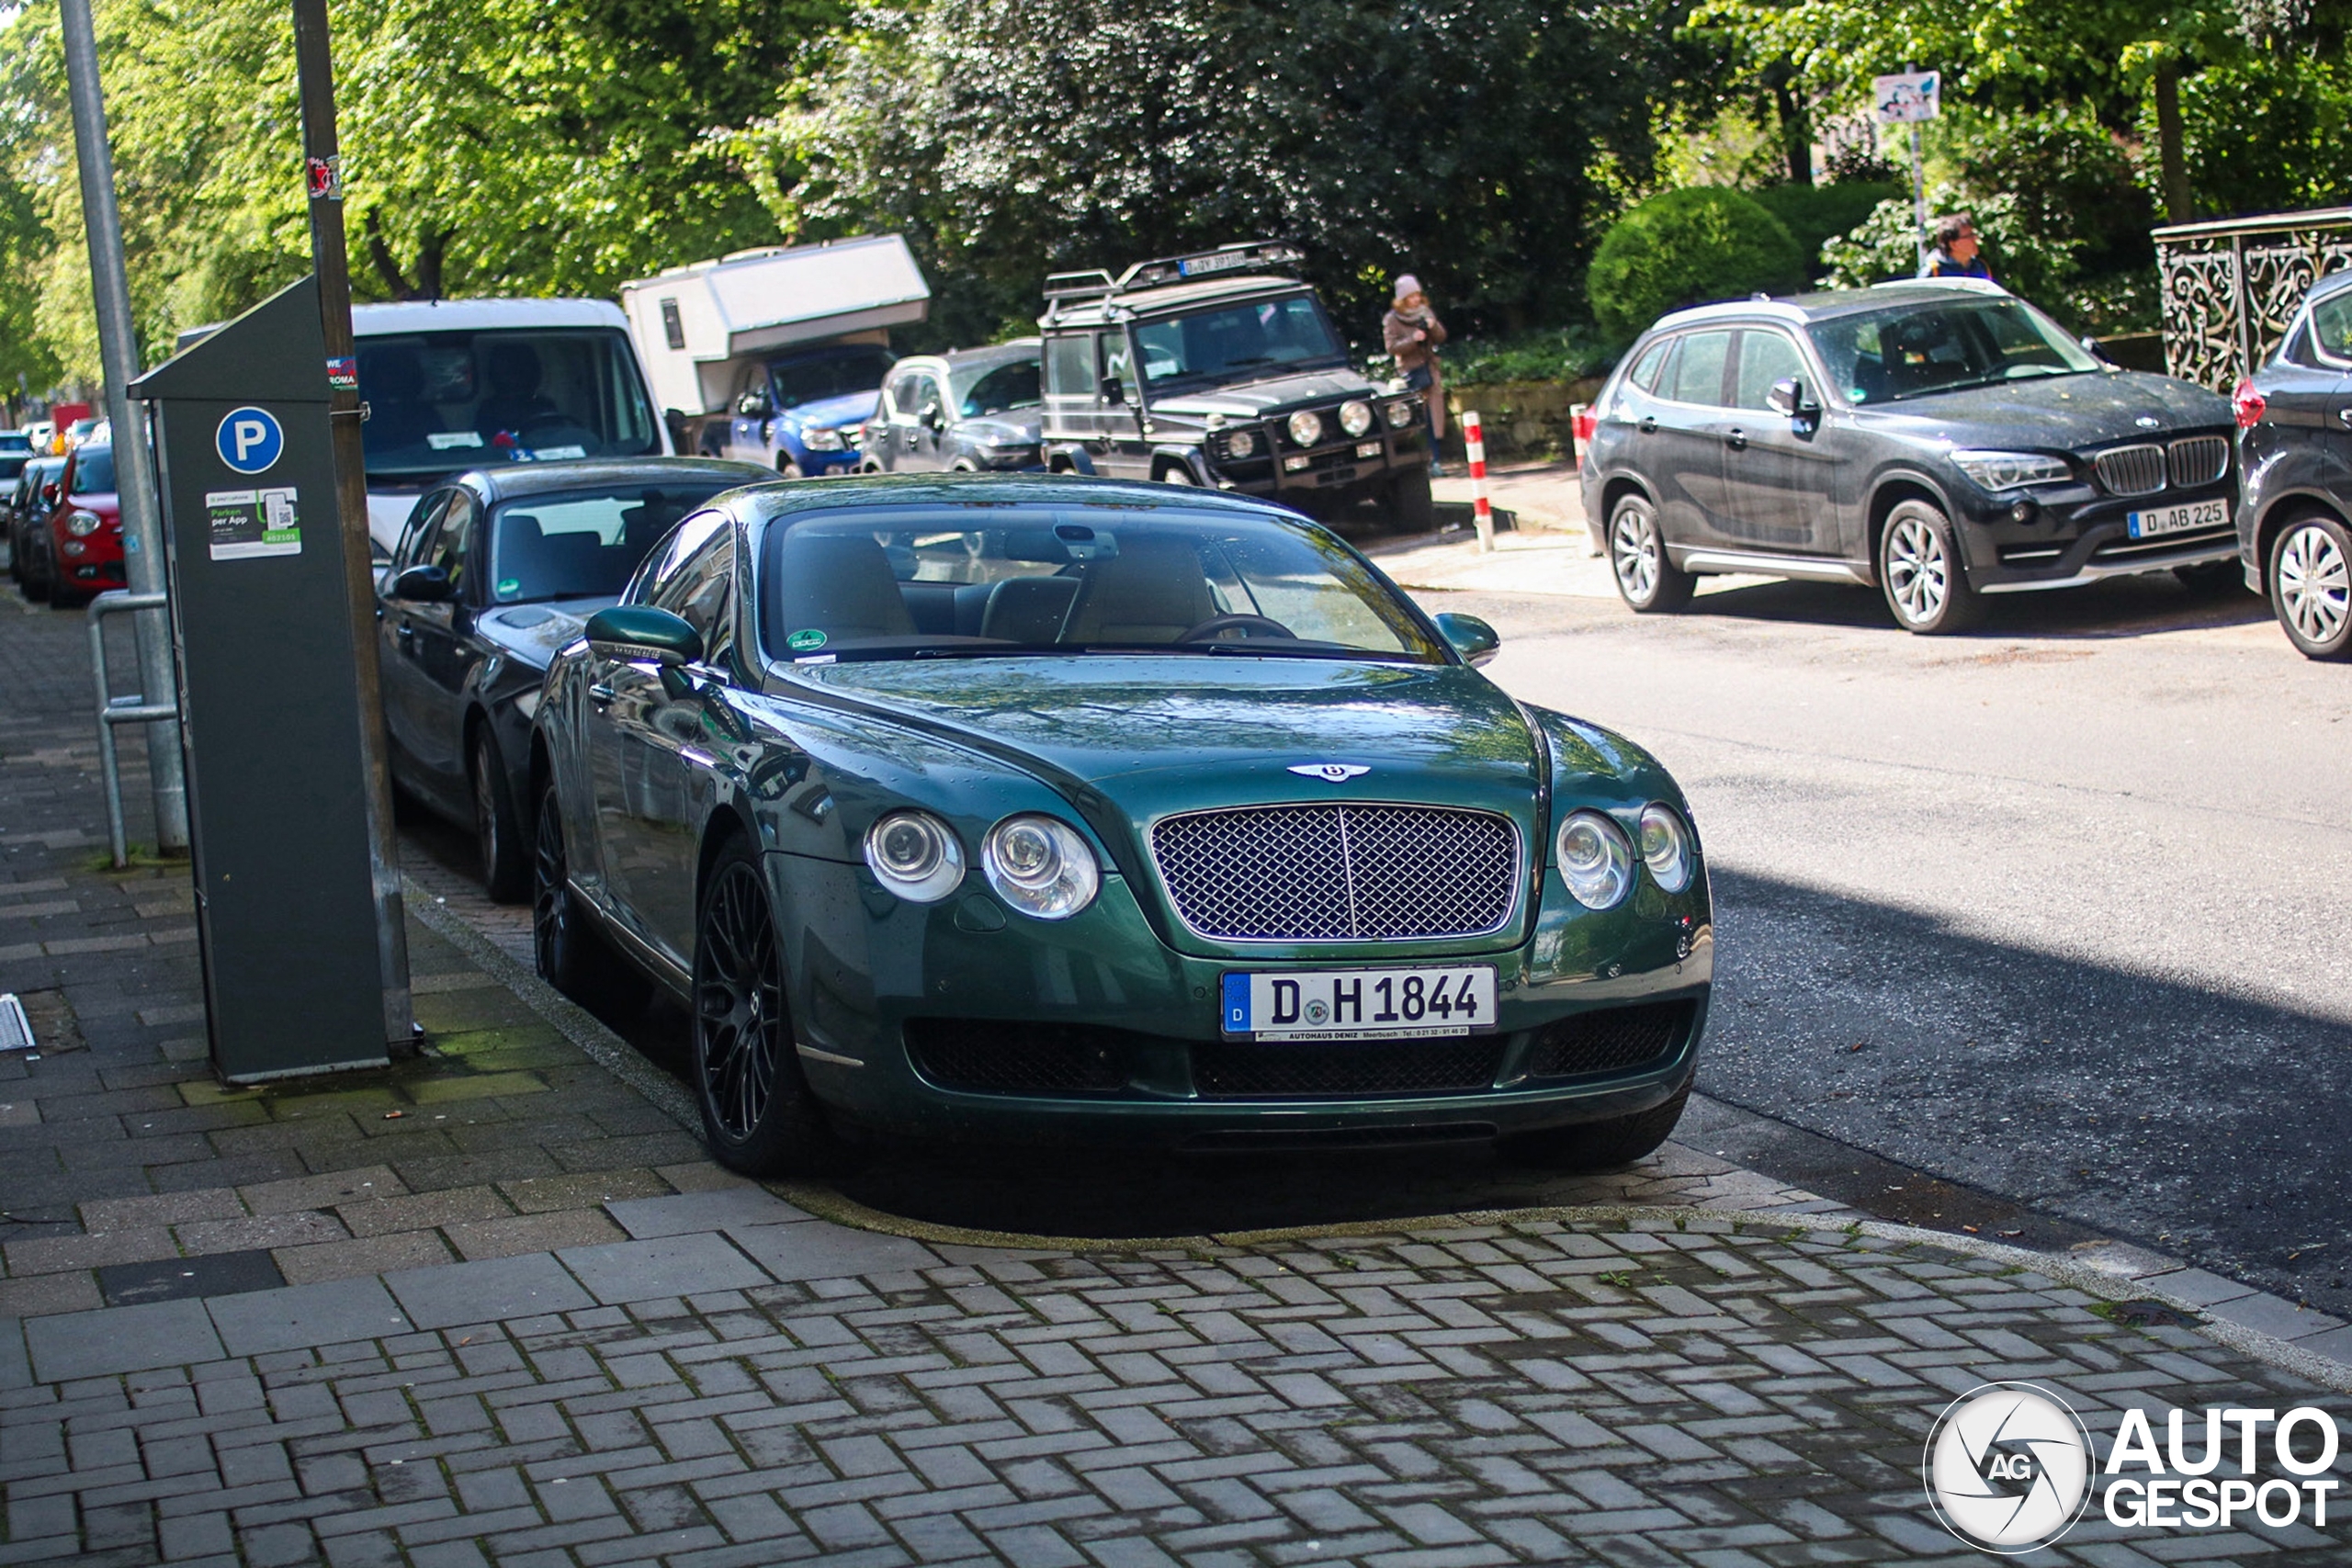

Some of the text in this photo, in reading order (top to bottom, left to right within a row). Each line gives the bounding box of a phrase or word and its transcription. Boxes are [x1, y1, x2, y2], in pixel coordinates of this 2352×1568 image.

[234, 420, 266, 461] P
[211, 508, 242, 518] Parken
[212, 515, 248, 527] per App
[2146, 502, 2222, 532] D AB 225
[1272, 979, 1301, 1024] D
[1233, 1009, 1242, 1021] D
